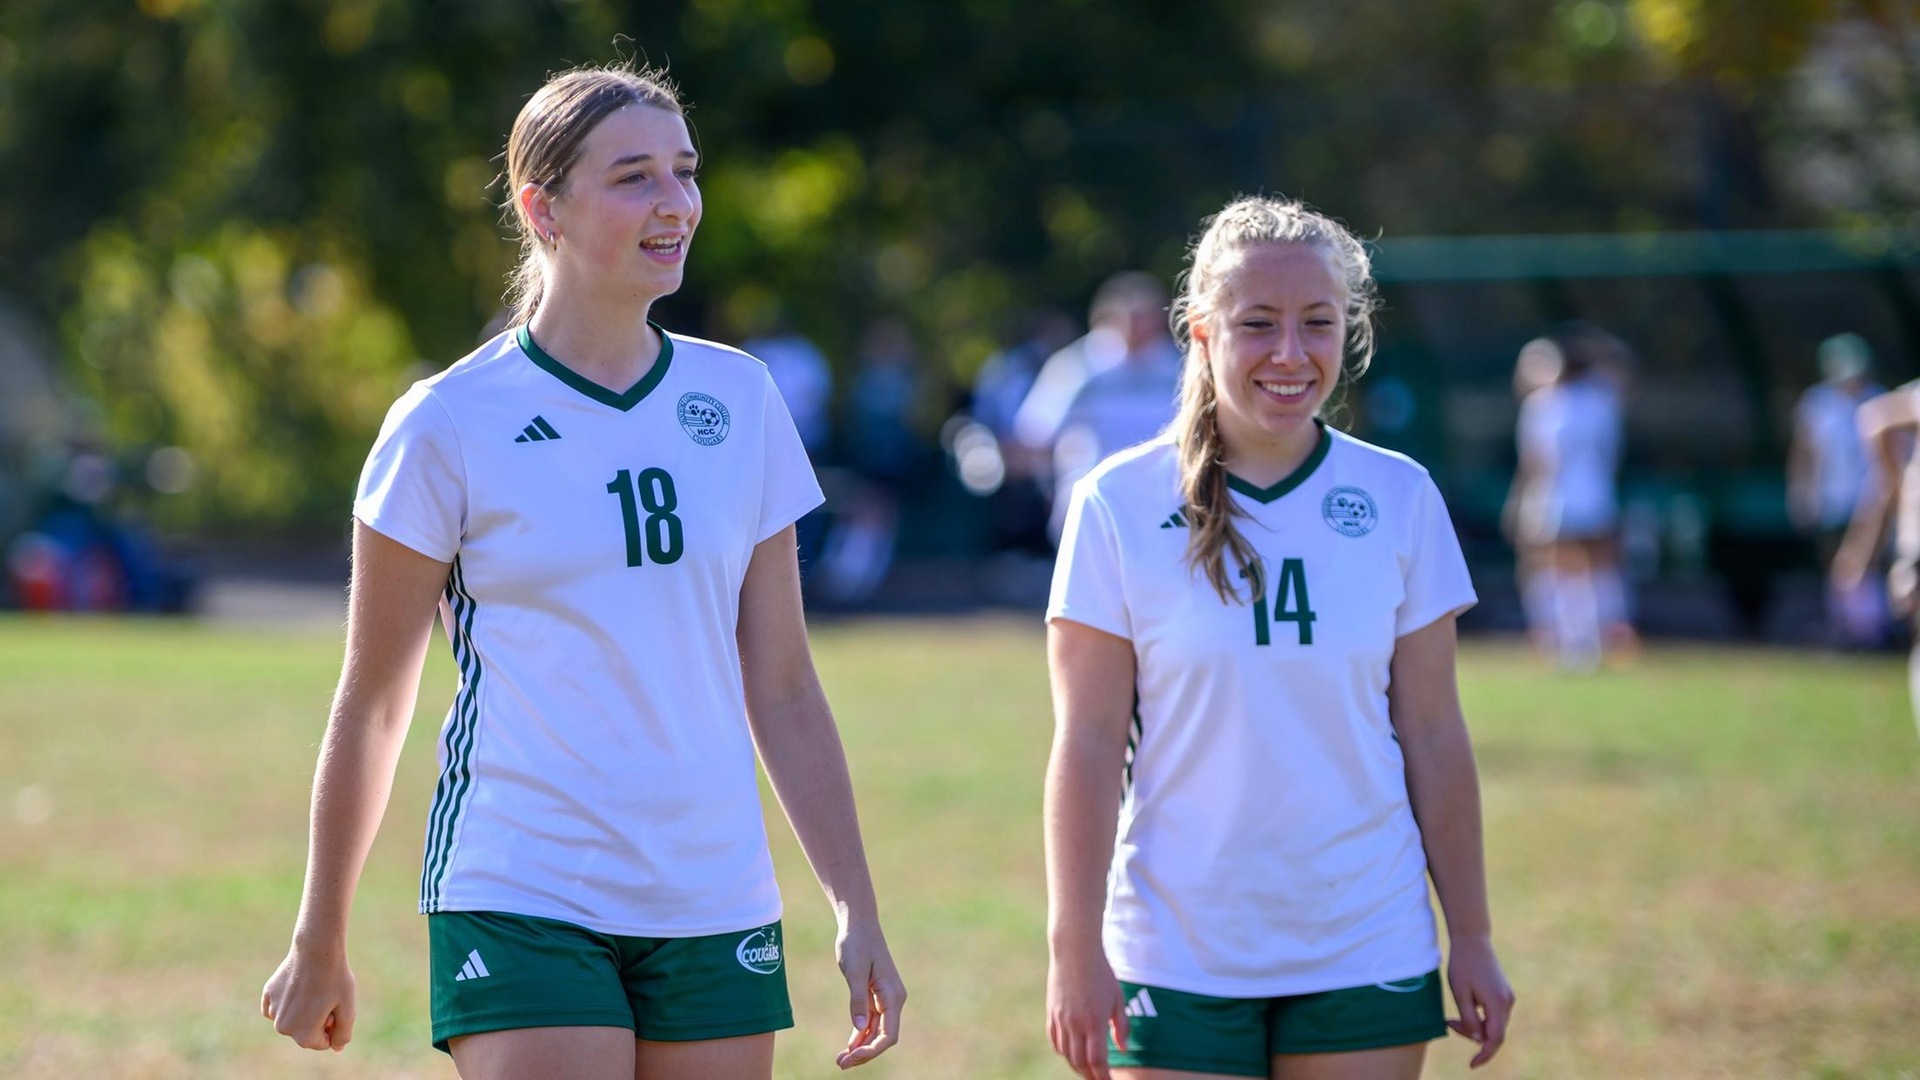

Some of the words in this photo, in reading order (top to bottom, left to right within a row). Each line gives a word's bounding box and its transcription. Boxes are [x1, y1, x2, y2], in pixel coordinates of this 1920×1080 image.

[693, 434, 724, 446] COUGARS
[697, 428, 716, 436] HCC
[606, 467, 684, 567] 18
[1239, 557, 1317, 645] 14
[742, 944, 779, 963] COUGARS
